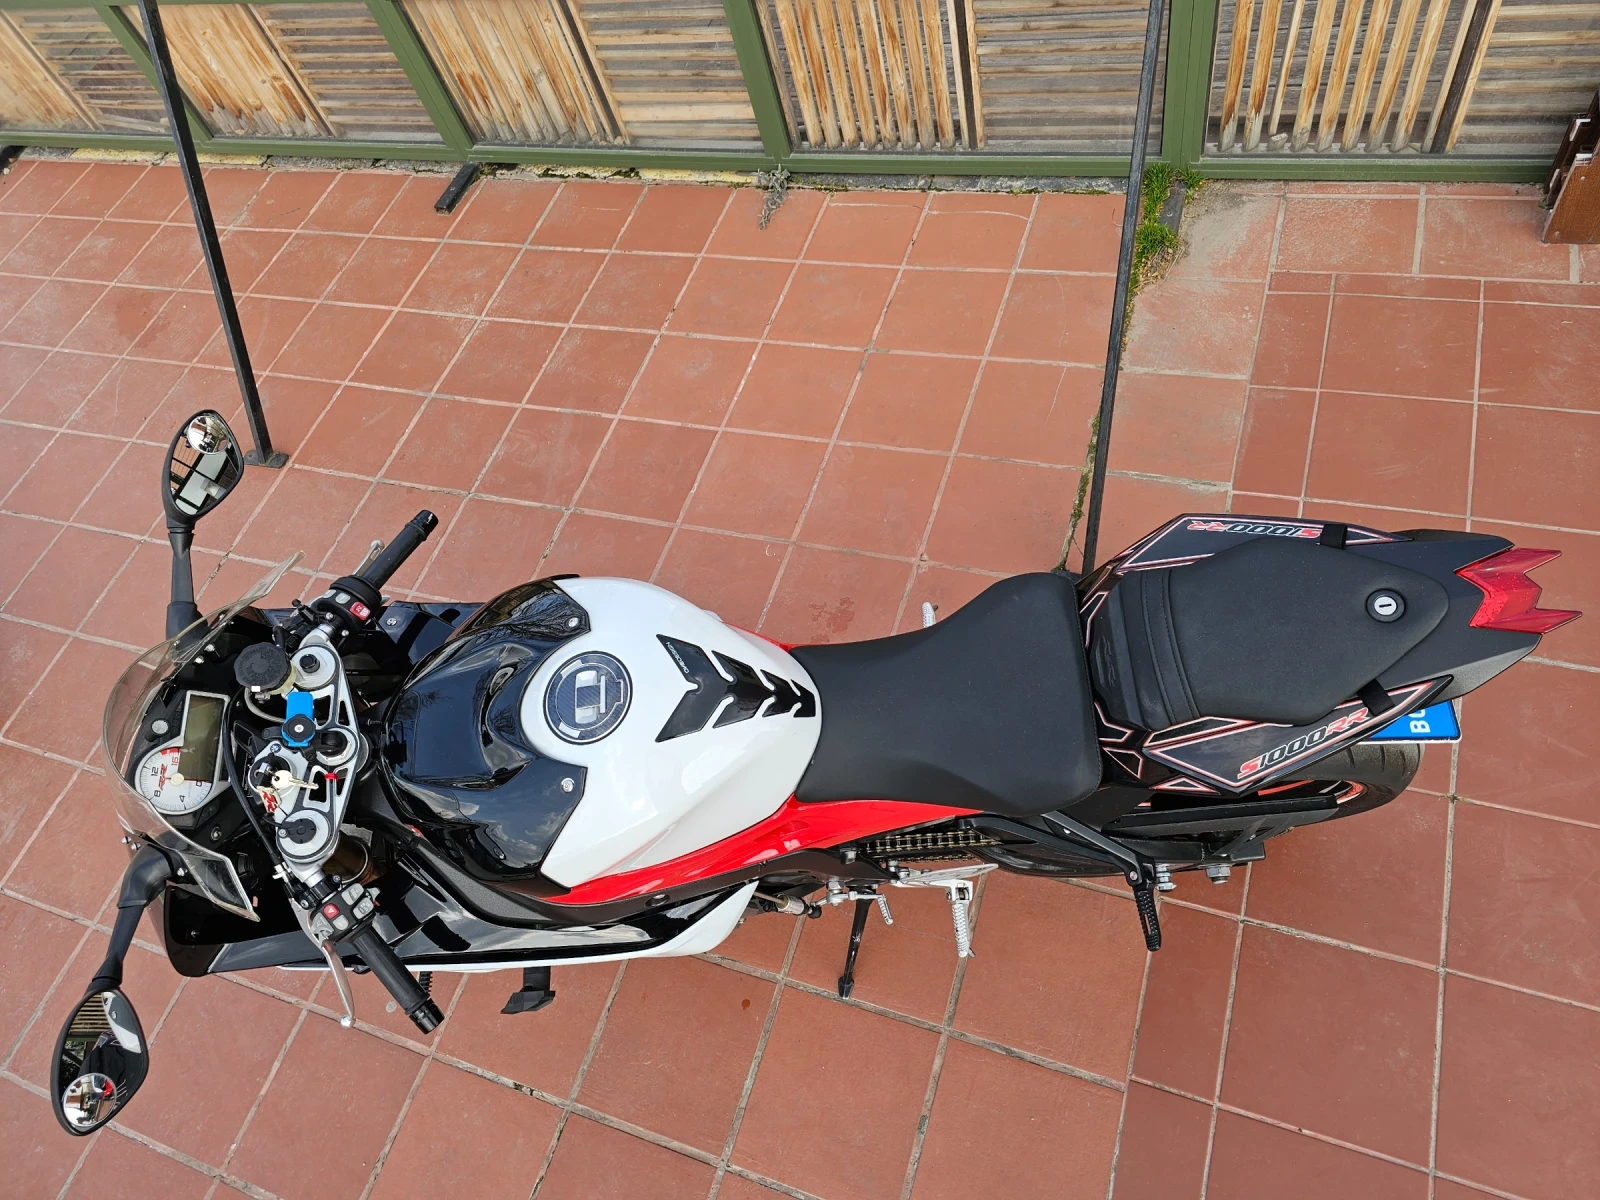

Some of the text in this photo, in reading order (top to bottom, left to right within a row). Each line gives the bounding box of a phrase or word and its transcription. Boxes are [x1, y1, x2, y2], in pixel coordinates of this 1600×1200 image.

[171, 756, 179, 767] 16
[151, 766, 159, 777] 12
[153, 790, 161, 798] 8
[179, 794, 185, 803] 4
